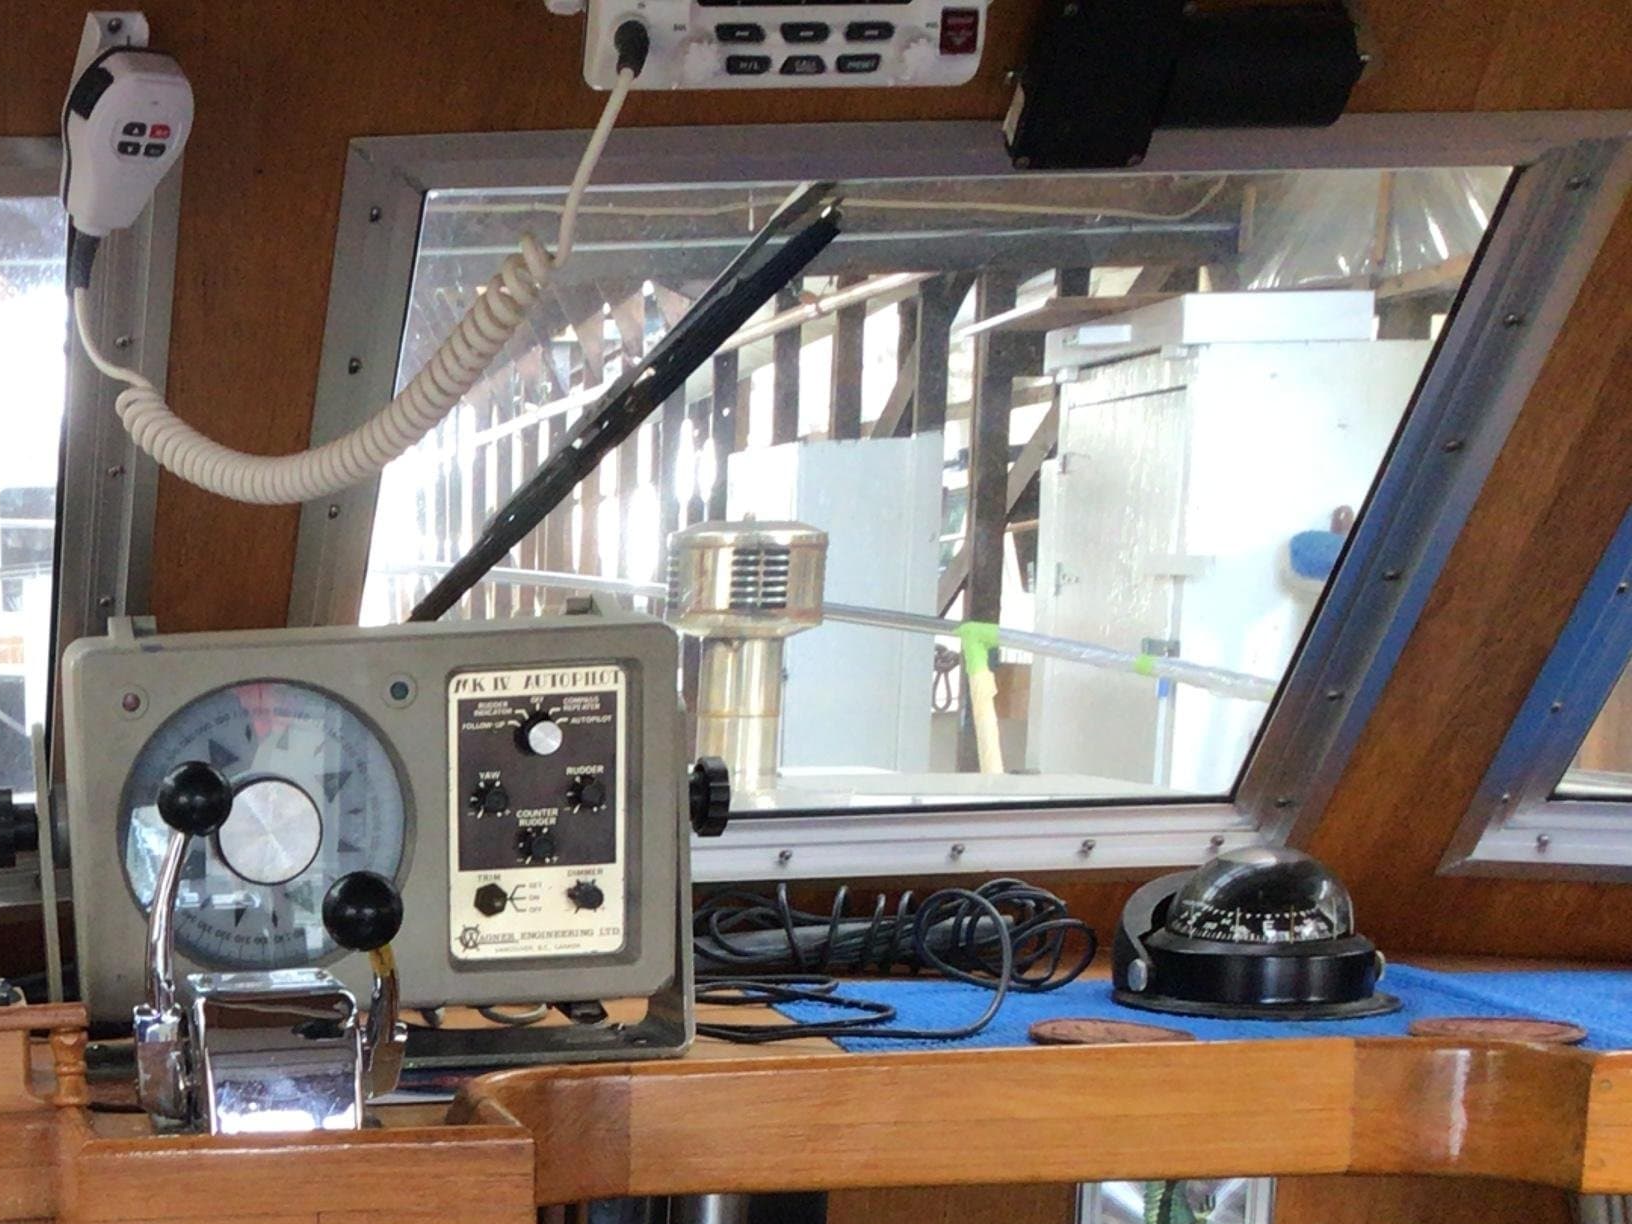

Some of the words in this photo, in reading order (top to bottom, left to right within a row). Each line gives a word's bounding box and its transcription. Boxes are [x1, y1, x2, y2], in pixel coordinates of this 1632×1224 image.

[523, 669, 620, 690] AUTOPILOT
[477, 700, 509, 709] RUDDER
[570, 715, 613, 724] AUTOPILOT
[566, 765, 605, 775] RUDDER
[478, 771, 501, 780] YAW
[516, 808, 559, 818] COUNTER
[518, 817, 557, 827] RUDDER
[477, 873, 501, 882] TRIM
[520, 928, 597, 940] ENGINEERING
[599, 926, 620, 937] LTD
